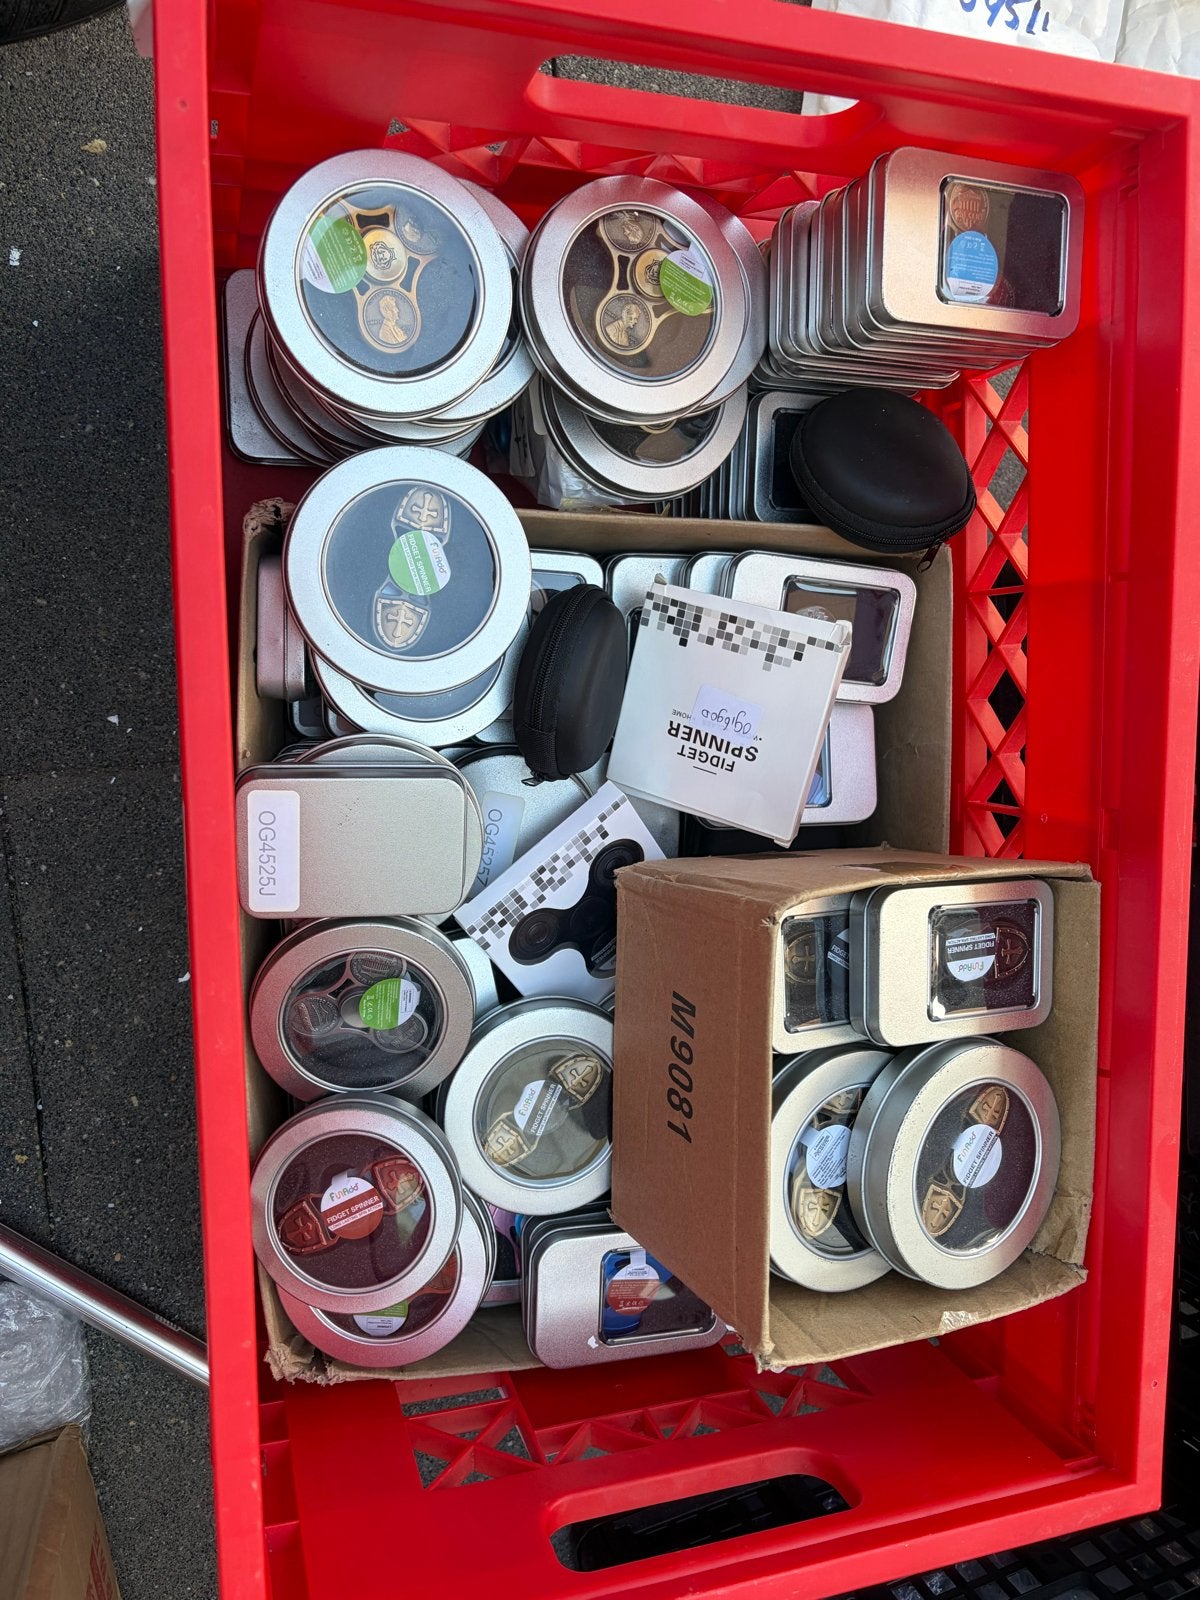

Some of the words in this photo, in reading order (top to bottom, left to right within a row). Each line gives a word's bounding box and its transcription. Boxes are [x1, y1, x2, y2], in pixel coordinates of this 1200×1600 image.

[407, 533, 420, 559] FIDGET
[416, 560, 431, 592] SPINNER
[667, 720, 759, 762] SPINNER
[677, 745, 735, 772] FIDGET
[258, 811, 276, 896] OG4525J
[947, 944, 972, 953] SPINNER
[974, 940, 994, 949] FIDGET
[667, 991, 696, 1143] M9081
[530, 1110, 543, 1133] FIDGET
[540, 1083, 555, 1110] SPINNER
[962, 1159, 978, 1183] FIDGET
[975, 1130, 994, 1159] SPINNER
[326, 1208, 350, 1224] FIDGET
[350, 1195, 379, 1213] SPINNER
